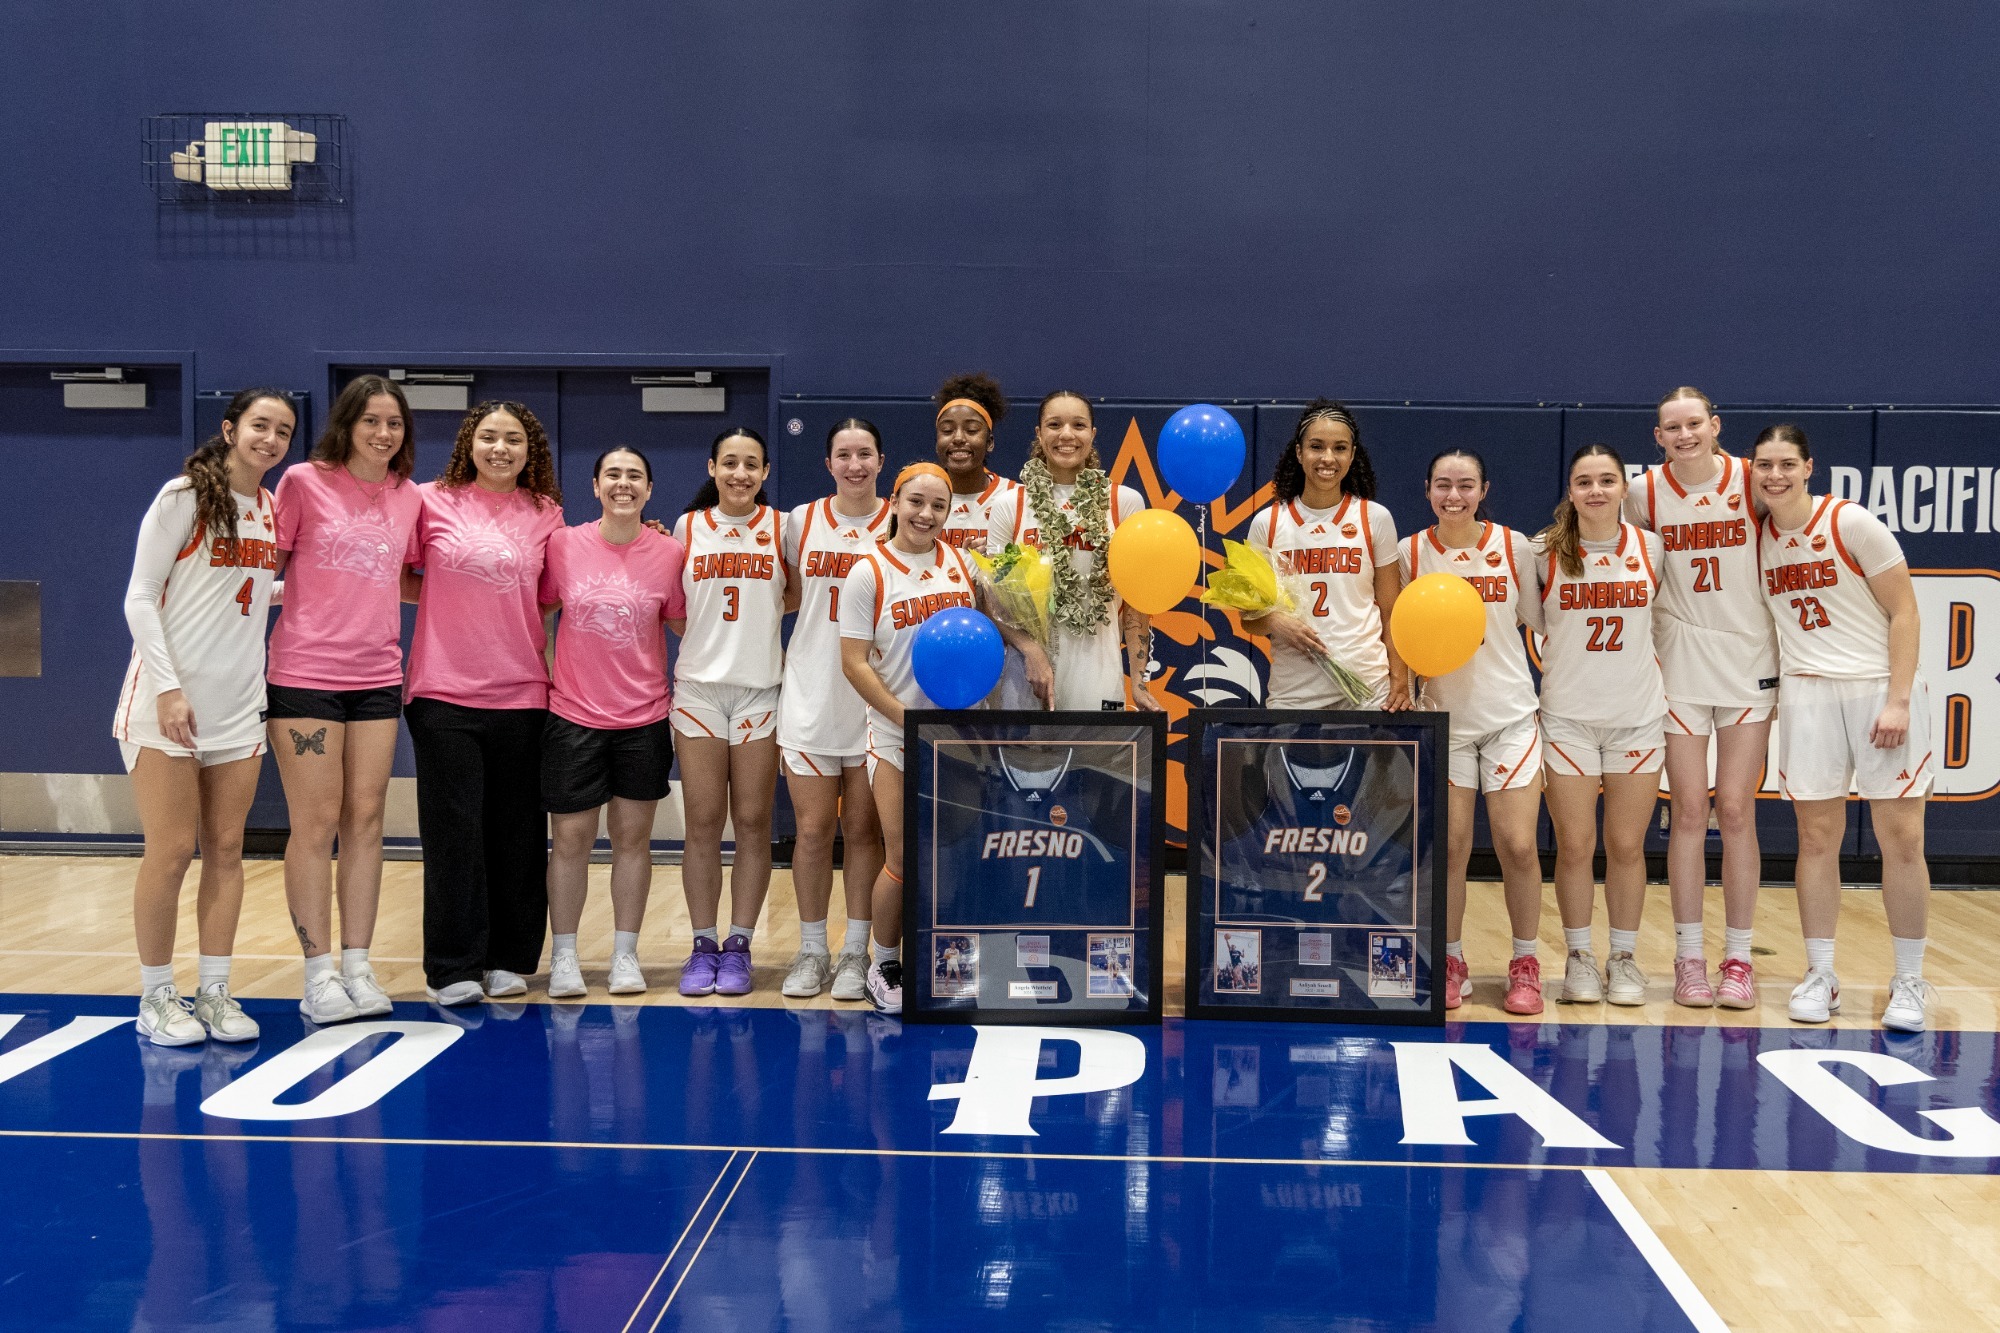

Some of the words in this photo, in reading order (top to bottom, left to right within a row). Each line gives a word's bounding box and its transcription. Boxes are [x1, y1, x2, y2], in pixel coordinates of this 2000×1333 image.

[222, 128, 272, 168] EXIT
[1830, 465, 2000, 533] PACIFI
[1661, 518, 1746, 552] SUNBIRDS
[693, 552, 774, 582] SUNBIRDS
[1690, 556, 1723, 593] 21
[1765, 559, 1838, 597] SUNBIRDS
[236, 577, 255, 616] 4
[722, 586, 740, 622] 3
[1310, 581, 1329, 617] 2
[1559, 580, 1648, 611] SUNBIRDS
[1790, 596, 1832, 632] 23
[1585, 616, 1624, 652] 22
[981, 829, 1083, 859] FRESNO
[1264, 827, 1369, 856] FRESNO
[1023, 866, 1041, 908] 1
[1303, 861, 1327, 902] 2
